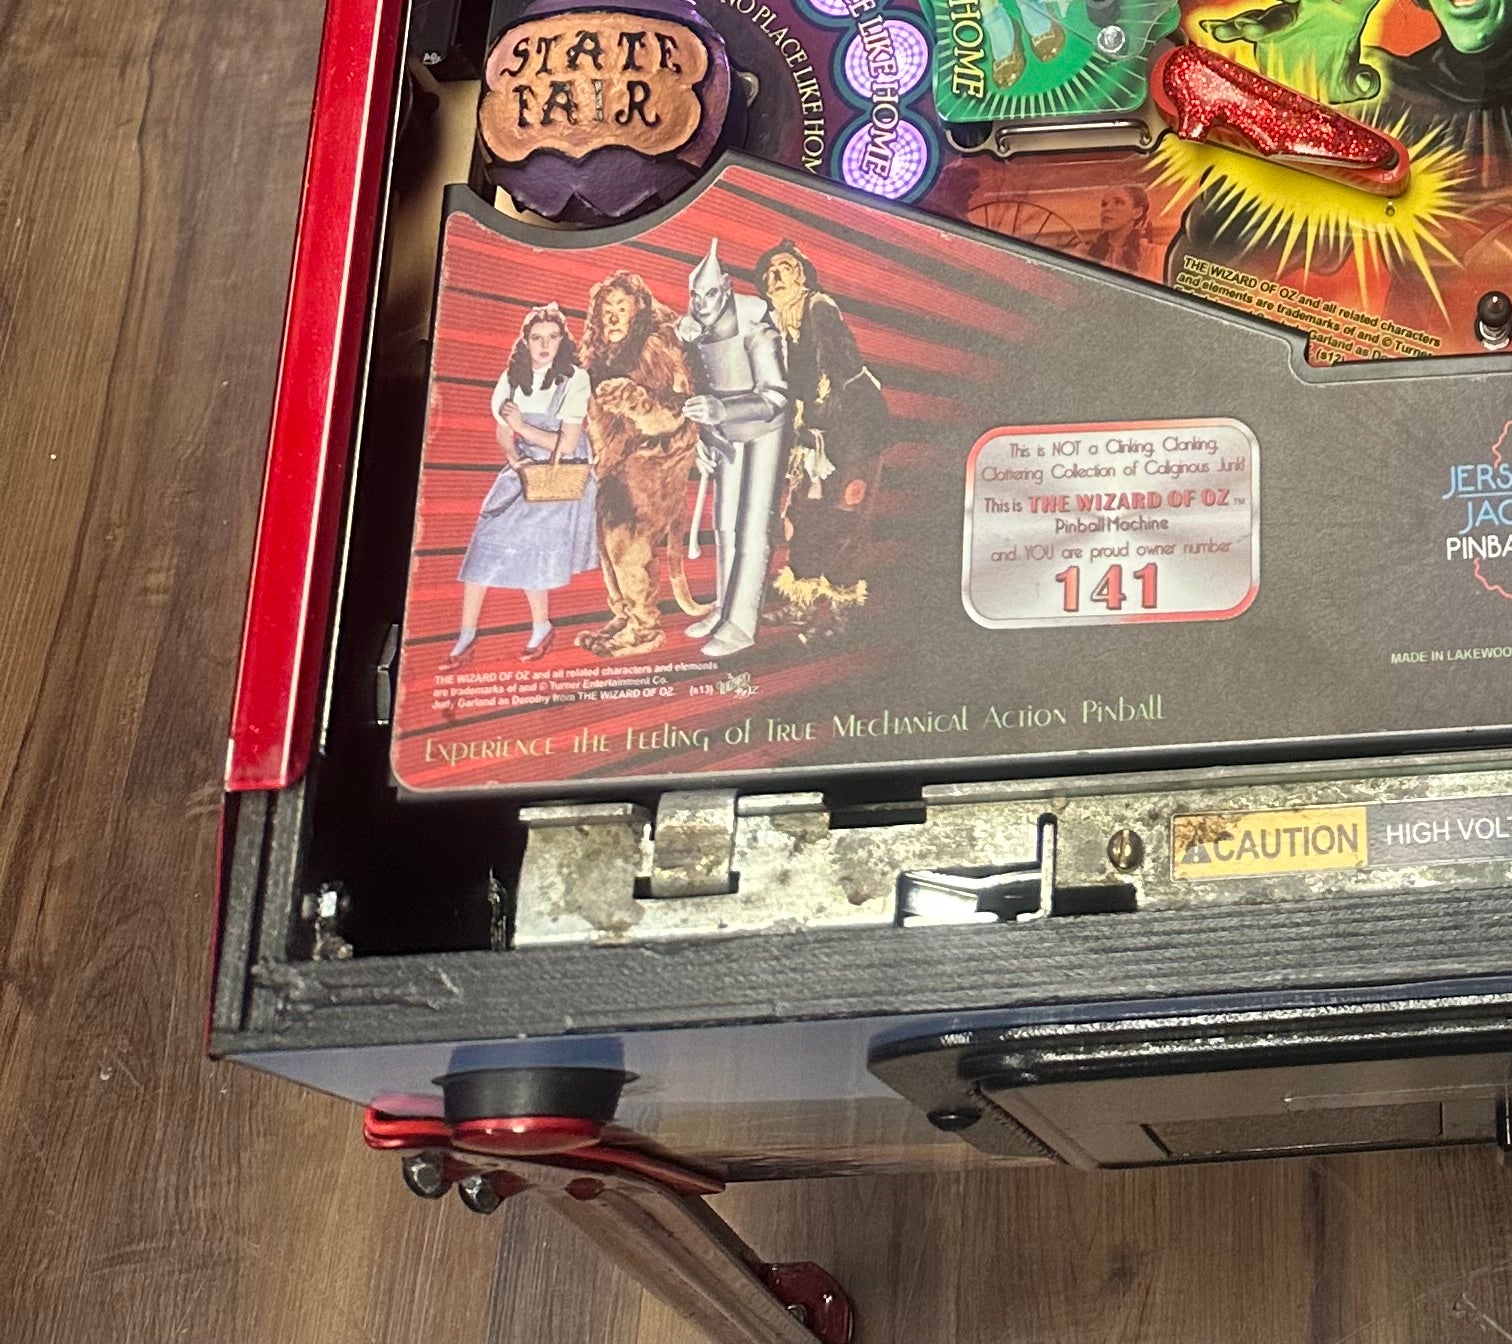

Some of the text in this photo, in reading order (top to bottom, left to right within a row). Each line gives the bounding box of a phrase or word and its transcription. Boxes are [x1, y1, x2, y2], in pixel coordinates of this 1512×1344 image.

[499, 29, 683, 77] STATE
[755, 3, 807, 68] PLACE
[792, 64, 825, 116] LIKE
[858, 15, 901, 79] LIKE
[512, 78, 662, 128] FAIR
[861, 80, 902, 180] HOME
[1177, 271, 1381, 346] and elements are trademarks and
[1183, 256, 1442, 349] THE WIZARD OF OZ and related characters
[1309, 328, 1353, 353] Garland
[1009, 439, 1082, 459] This NOT
[981, 457, 1211, 485] Clattering Collection of Caliginous
[983, 487, 1231, 514] This THE WIZARD OF OZ
[1055, 517, 1170, 535] Pinball Machine
[990, 537, 1232, 564] and YOU are proud owner number
[1054, 562, 1159, 614] 141
[1390, 649, 1429, 665] MADE
[1430, 649, 1446, 663] IN
[599, 687, 641, 701] WIZARD
[724, 717, 751, 745] of
[1211, 822, 1360, 862] CAUTION
[1385, 820, 1451, 847] HIGH
